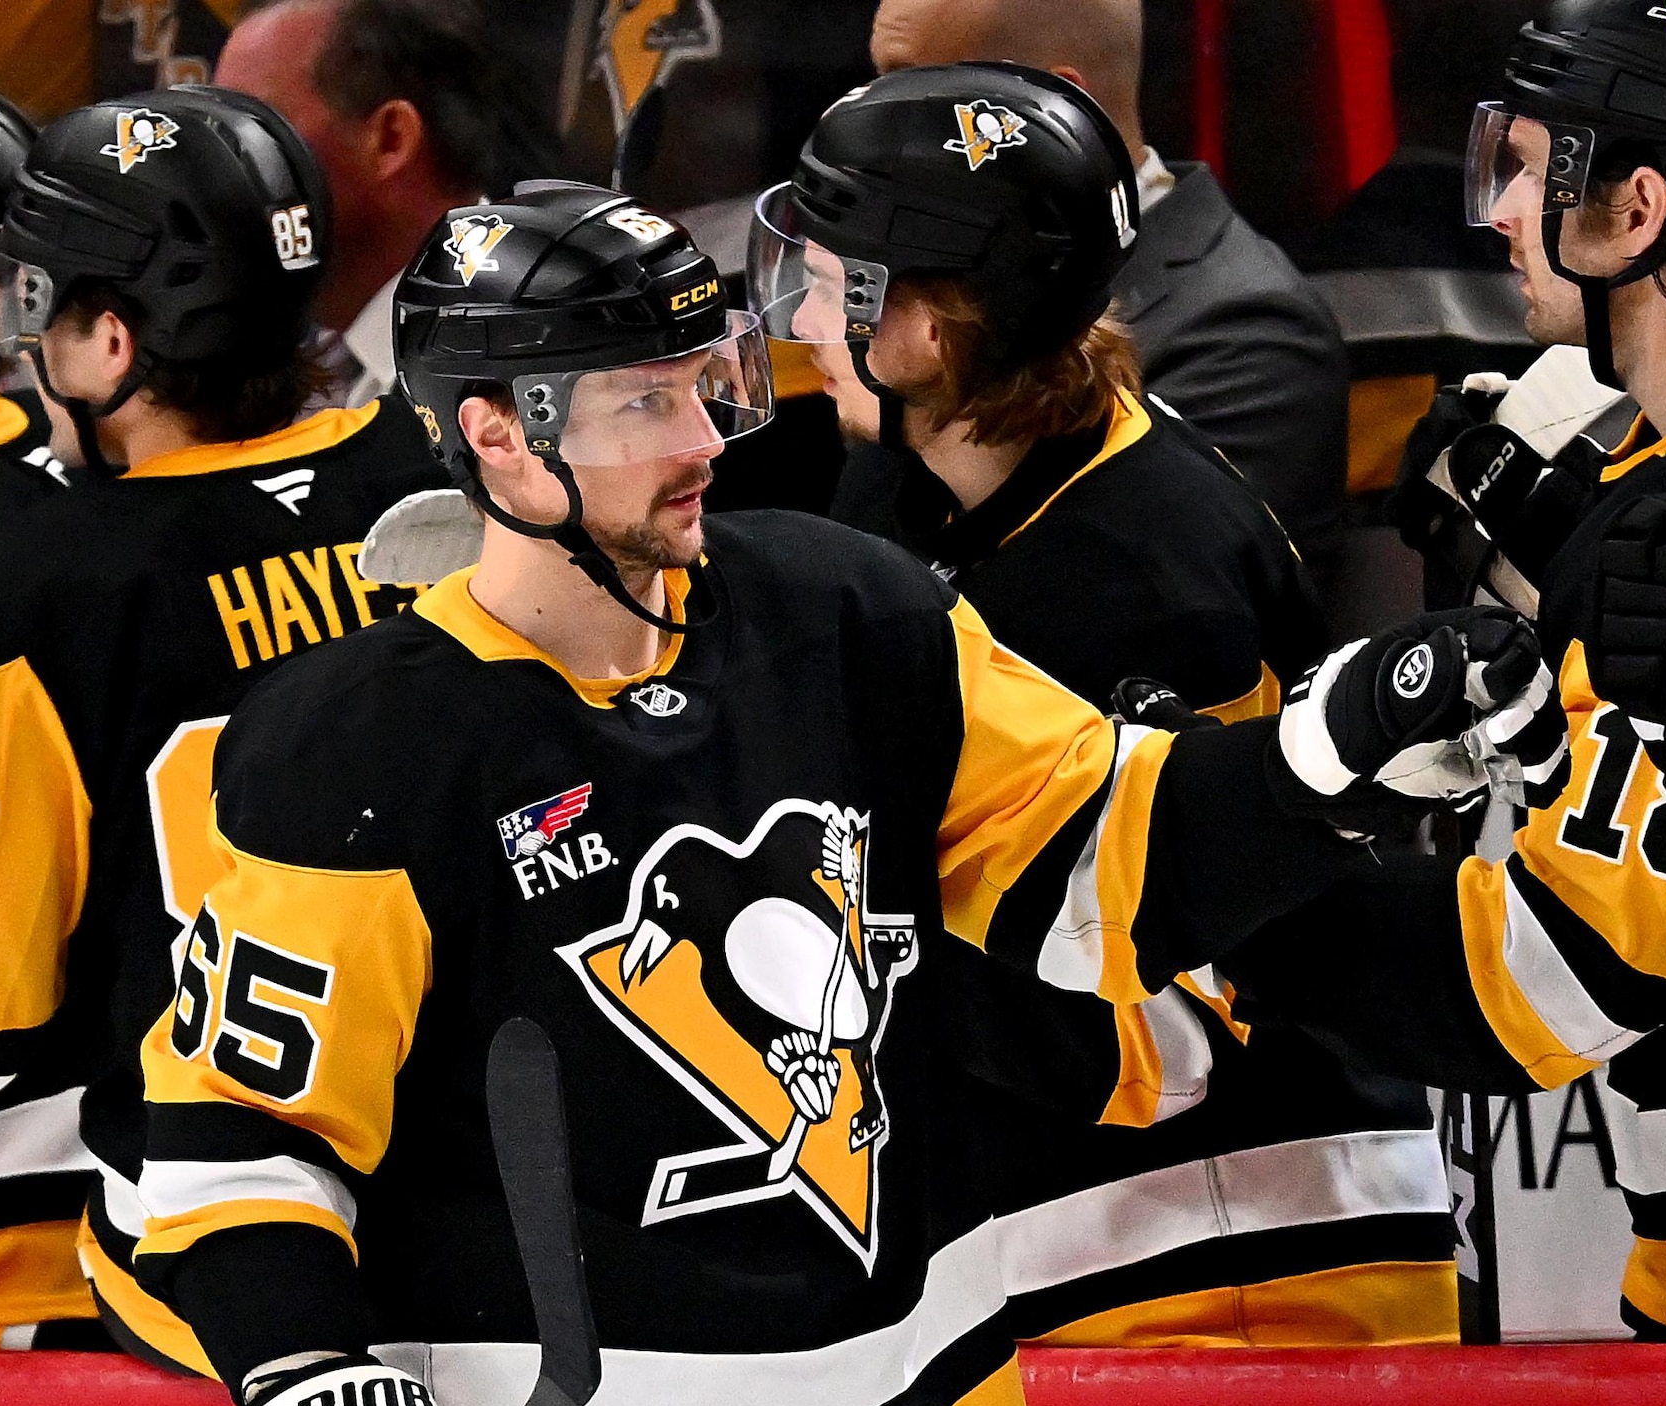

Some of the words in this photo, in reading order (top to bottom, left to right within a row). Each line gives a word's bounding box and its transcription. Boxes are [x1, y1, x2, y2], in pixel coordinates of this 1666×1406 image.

[271, 205, 313, 260] 85
[669, 278, 719, 312] CCM
[1470, 441, 1516, 502] CCM
[207, 540, 430, 670] HAYE
[512, 831, 620, 901] F.N.B.
[171, 893, 334, 1106] 65
